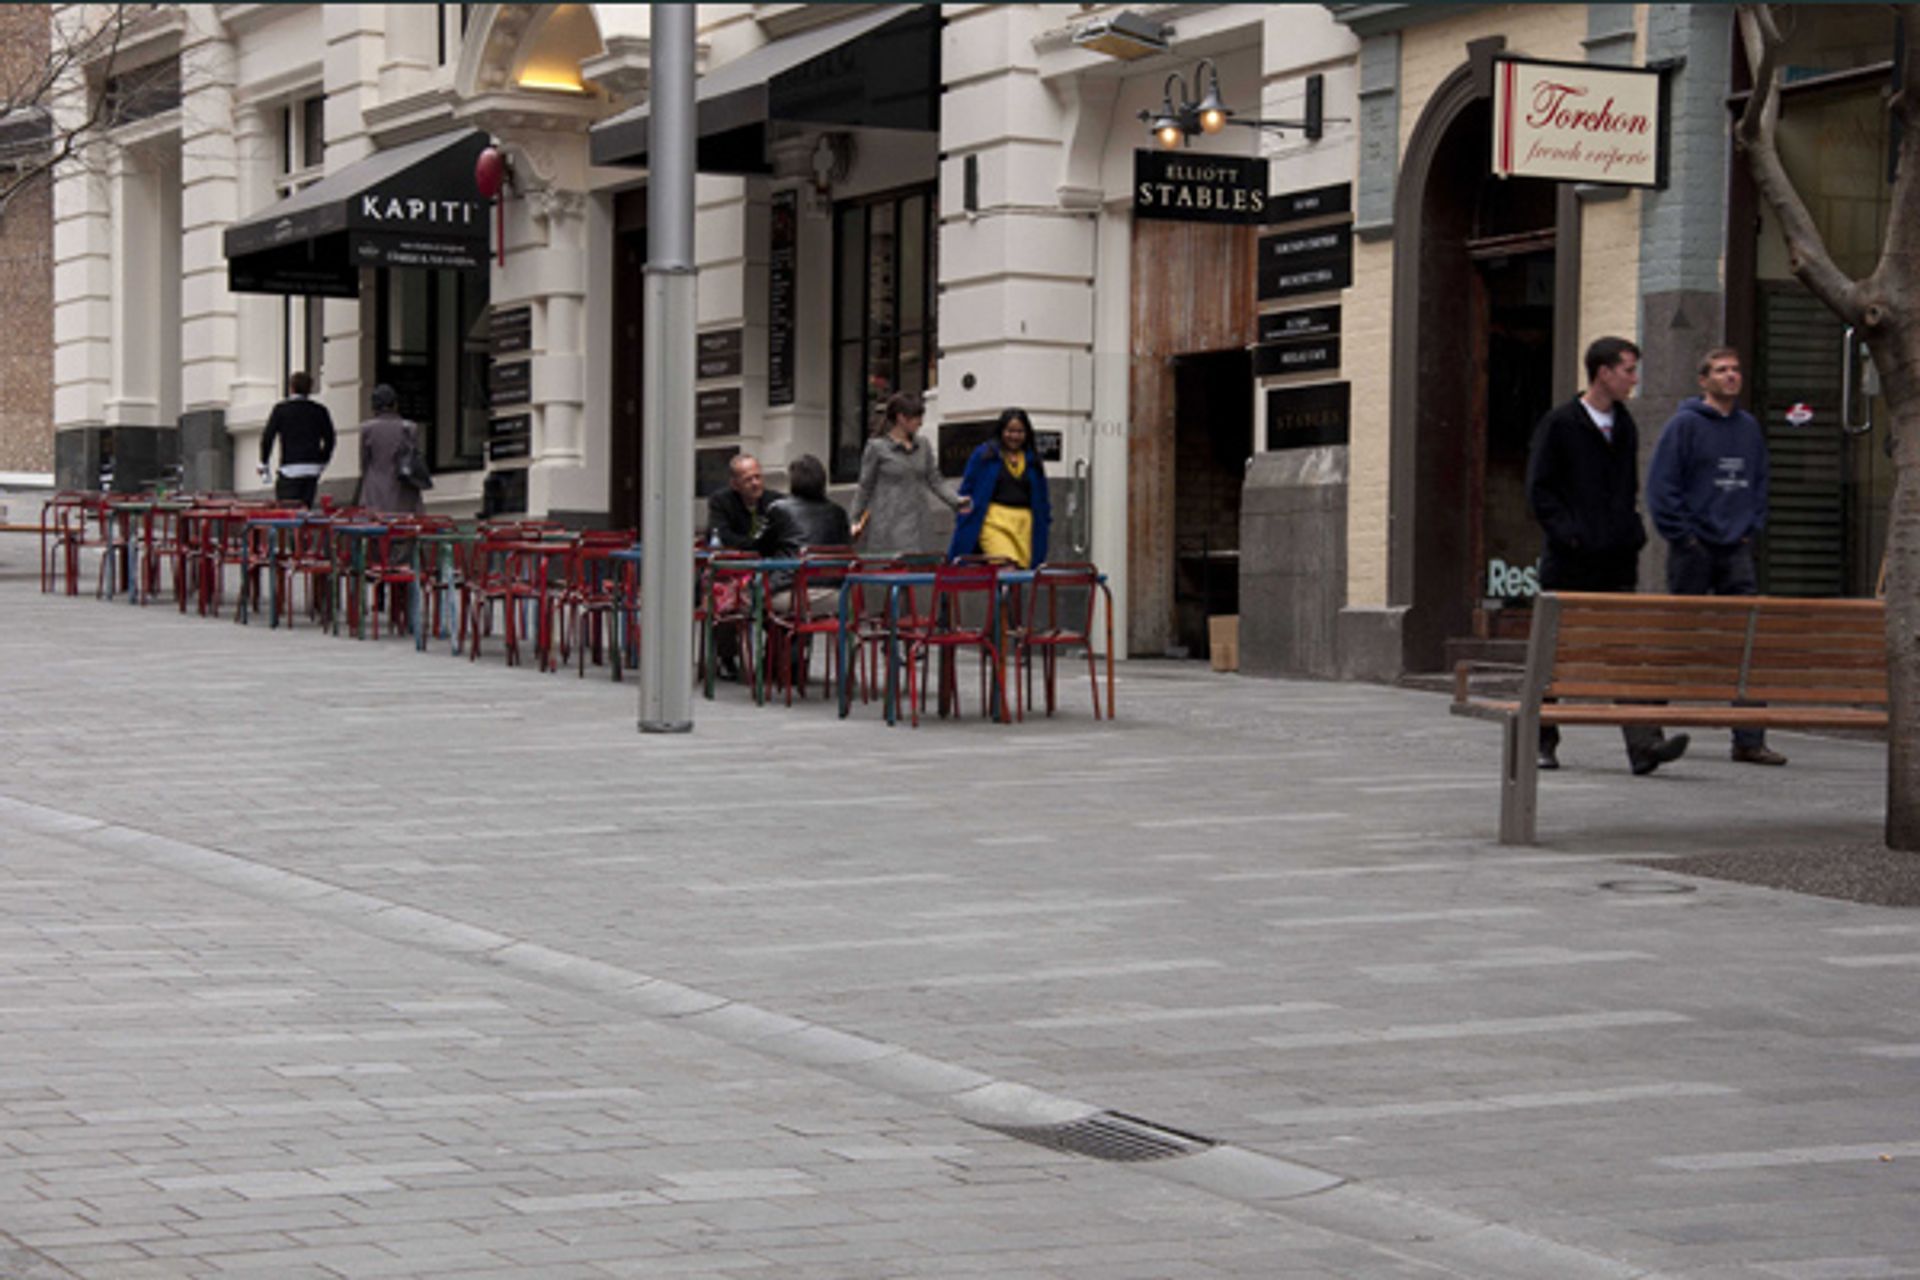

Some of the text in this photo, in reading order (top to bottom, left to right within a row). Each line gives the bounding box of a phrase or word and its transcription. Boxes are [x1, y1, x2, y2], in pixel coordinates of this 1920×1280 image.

[1526, 80, 1651, 134] Torchon
[1166, 164, 1239, 183] ELLIOTT
[362, 194, 471, 225] KAPITI
[1139, 182, 1265, 212] STABLES
